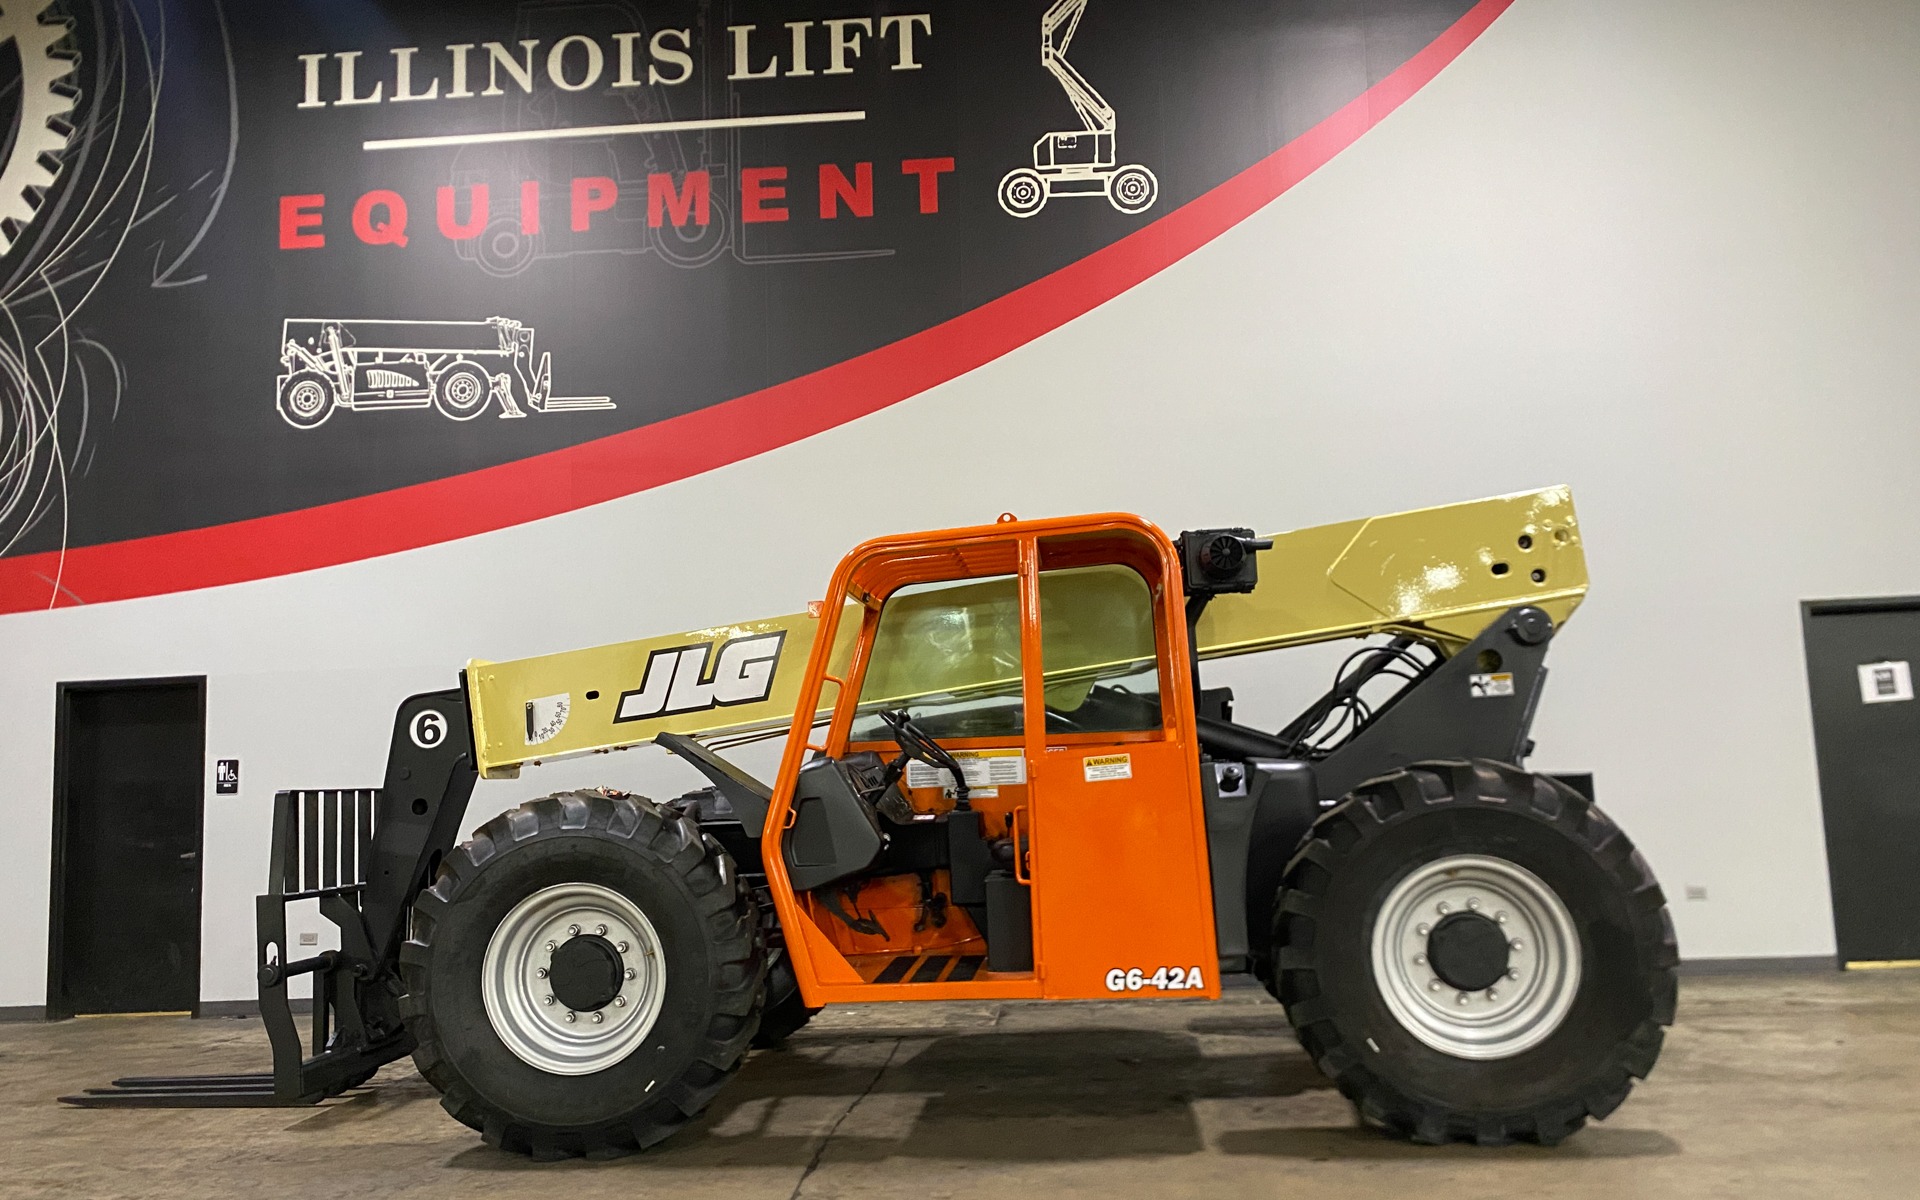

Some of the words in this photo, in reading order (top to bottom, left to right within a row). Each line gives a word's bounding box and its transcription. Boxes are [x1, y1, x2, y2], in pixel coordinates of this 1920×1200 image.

[298, 28, 693, 109] ILLINOIS
[727, 14, 932, 81] LIFT
[279, 157, 954, 250] EQUIPMENT
[614, 631, 786, 723] JLG
[416, 713, 441, 745] 6
[1094, 755, 1128, 765] WARNING
[1105, 966, 1204, 991] G6-42A
